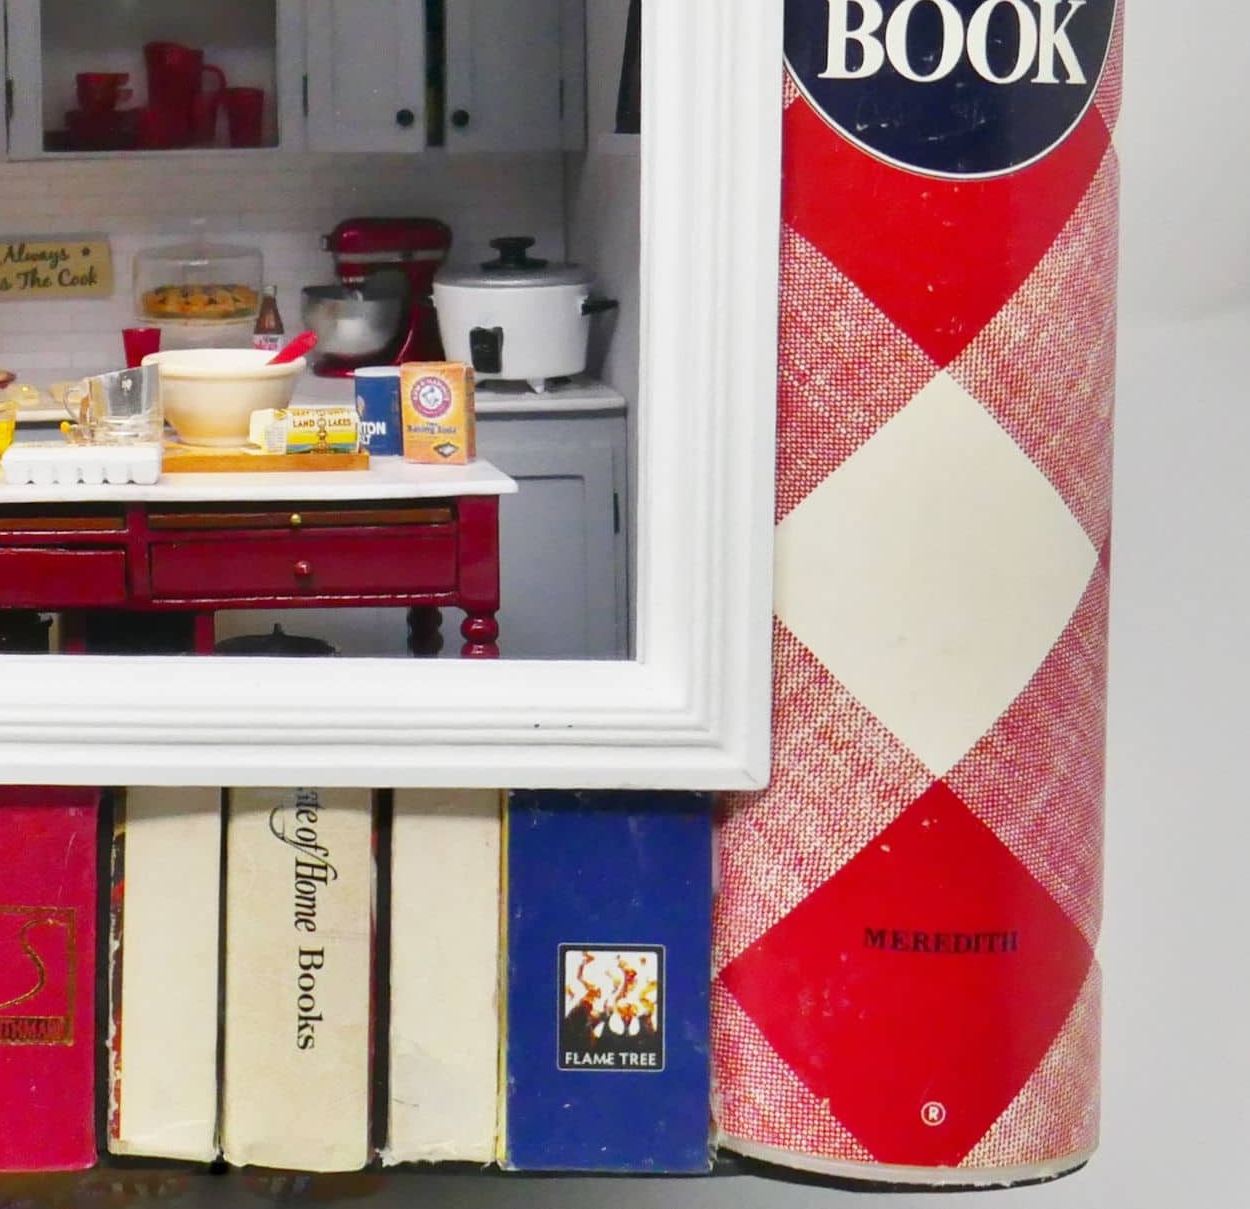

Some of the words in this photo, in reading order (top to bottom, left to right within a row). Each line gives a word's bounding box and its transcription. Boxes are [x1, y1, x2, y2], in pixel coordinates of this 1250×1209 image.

[0, 243, 70, 269] Always
[17, 267, 53, 290] The
[57, 265, 99, 288] Cook
[358, 421, 387, 436] TON
[293, 857, 331, 933] Home
[863, 927, 1018, 953] MEREDITH
[296, 946, 326, 1051] Books
[565, 1052, 614, 1065] FLAME
[619, 1052, 657, 1066] TREE
